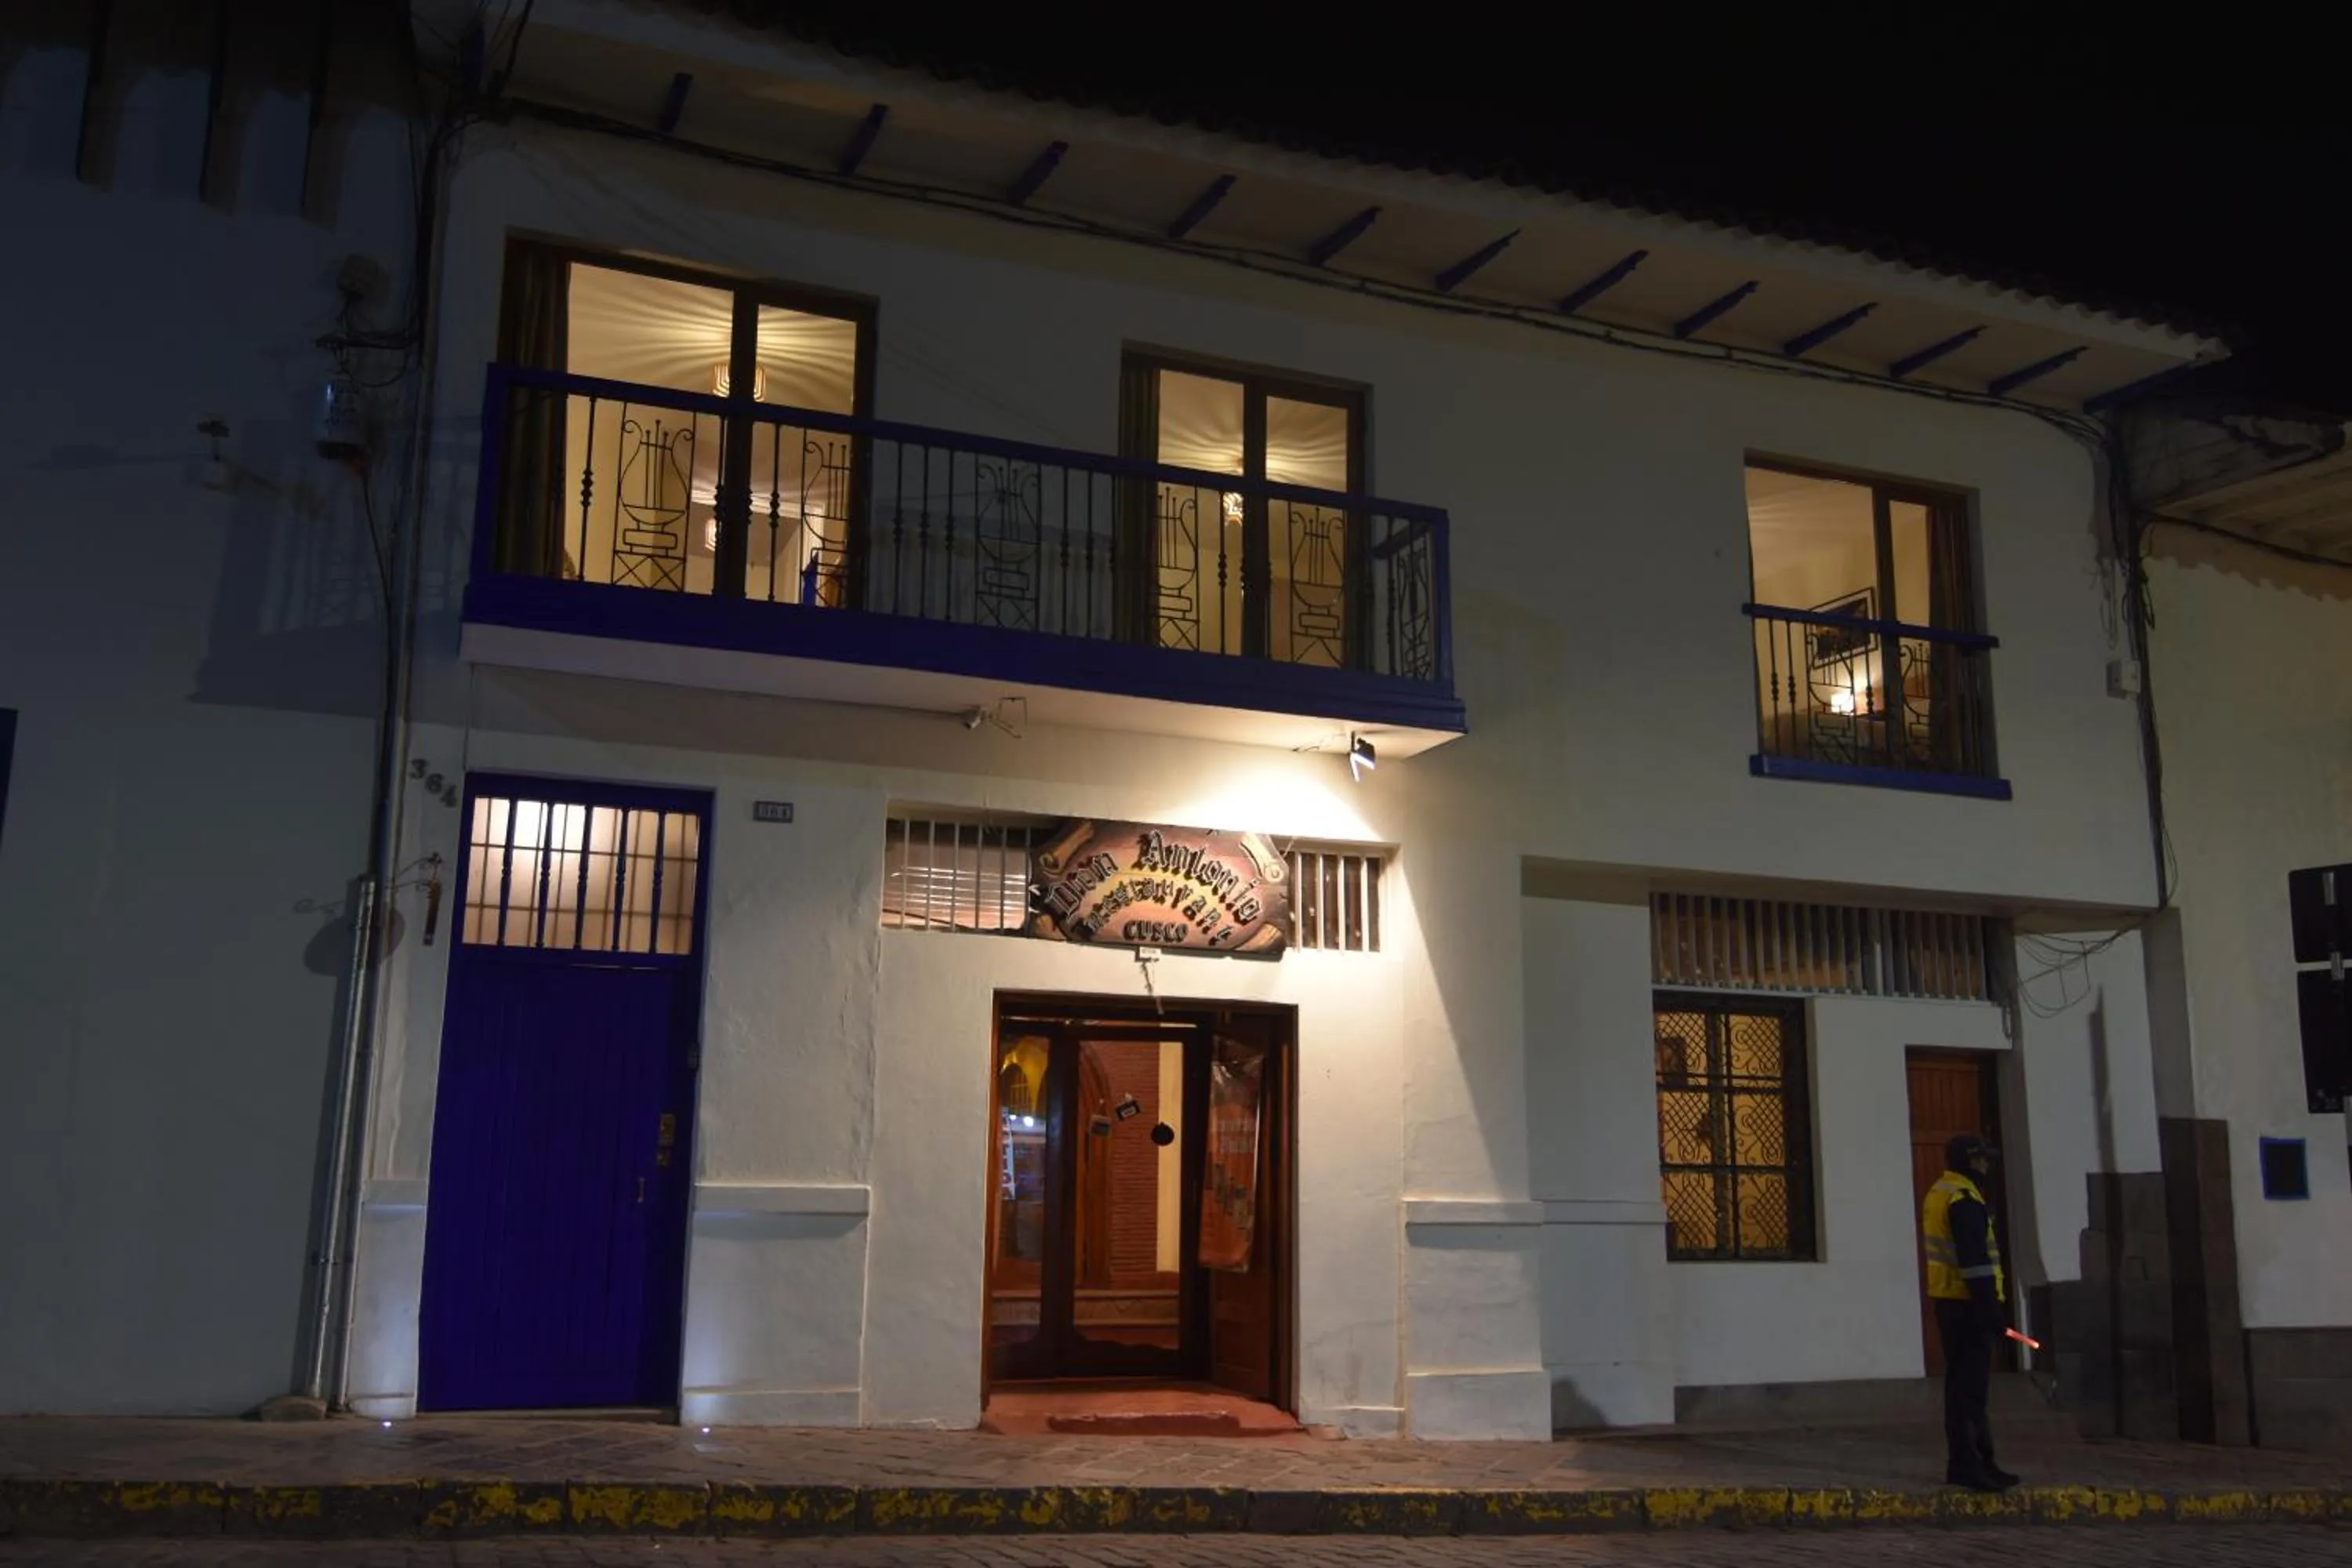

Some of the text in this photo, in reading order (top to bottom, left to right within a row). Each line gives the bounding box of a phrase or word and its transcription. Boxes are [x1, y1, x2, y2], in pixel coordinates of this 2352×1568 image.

[408, 758, 457, 808] 364
[1046, 830, 1261, 925] Don Antonio
[1122, 920, 1189, 942] CUSCO
